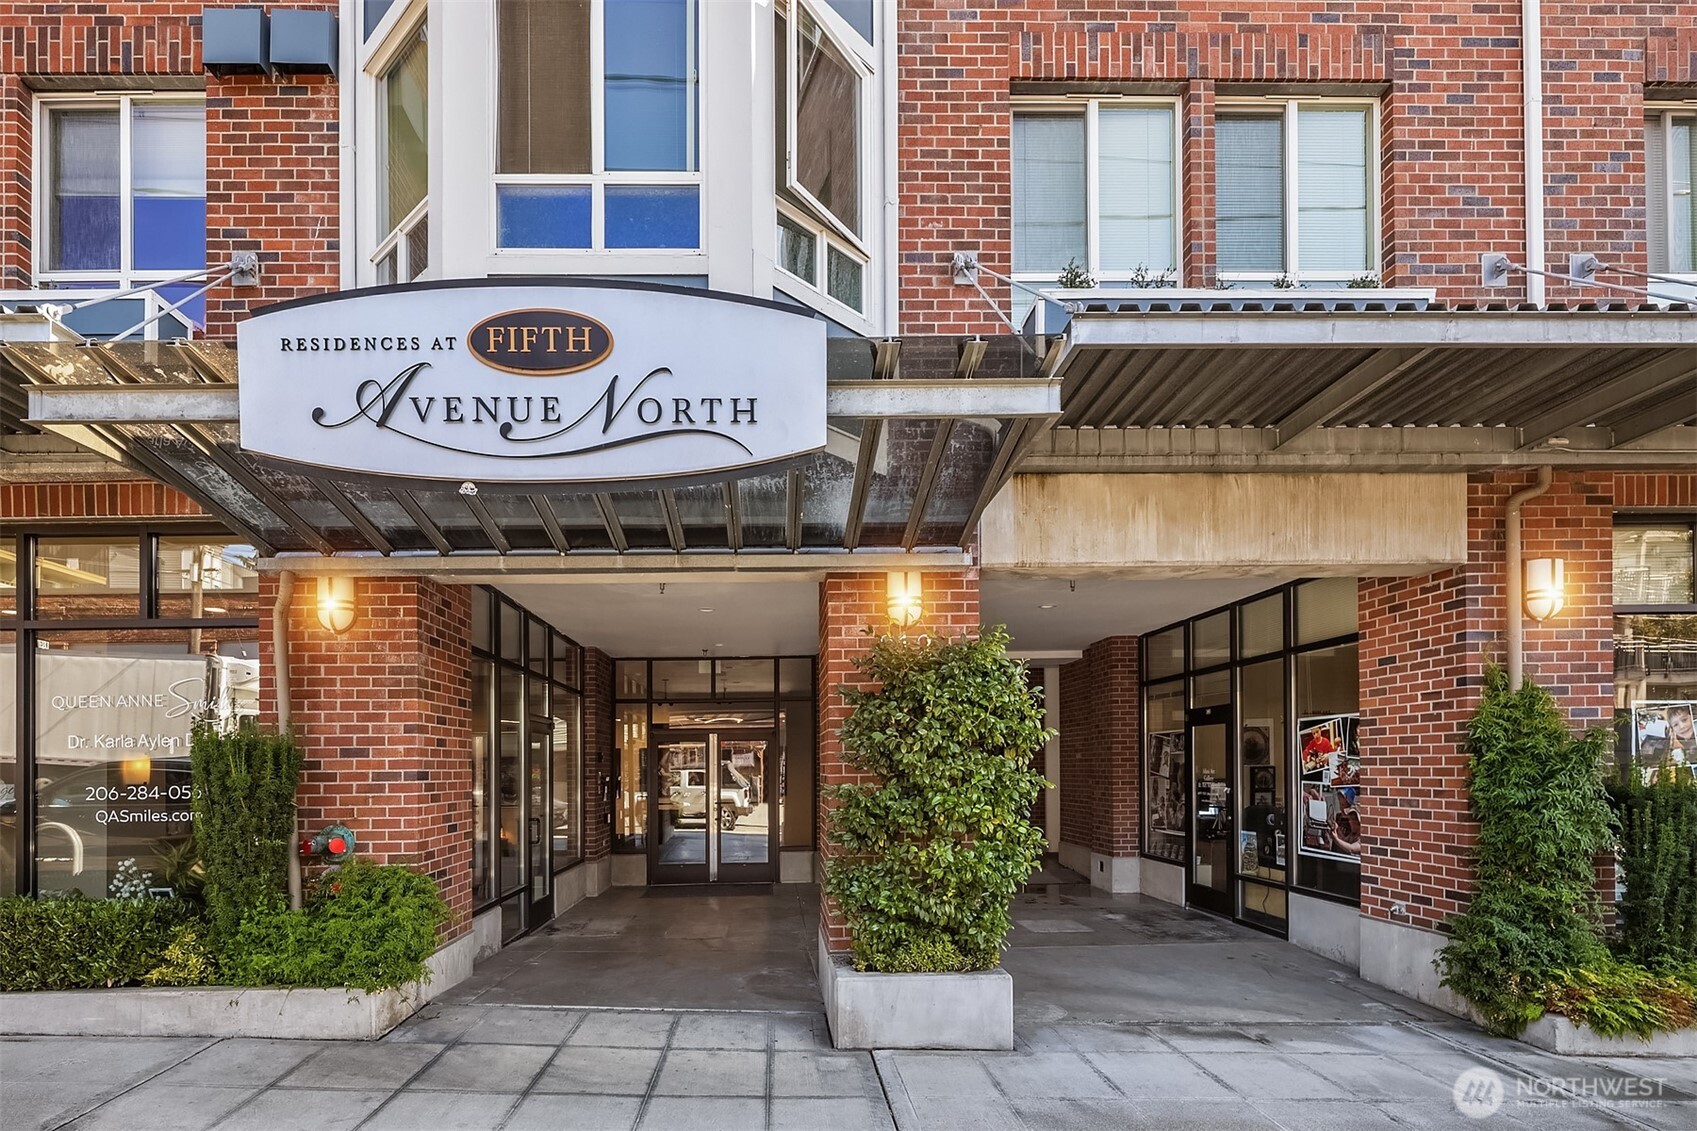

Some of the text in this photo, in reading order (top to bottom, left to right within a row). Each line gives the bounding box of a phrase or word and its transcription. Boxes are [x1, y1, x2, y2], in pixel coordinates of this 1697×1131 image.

[281, 326, 592, 353] RESIDENCES AT FIFTH
[311, 361, 758, 441] AVENUE NORTH
[51, 695, 111, 711] QUEEN
[115, 694, 164, 708] ANNE
[67, 734, 89, 749] Dr.
[94, 734, 134, 748] Karla
[137, 733, 180, 751] Aylen
[95, 809, 203, 825] QASmiles.com
